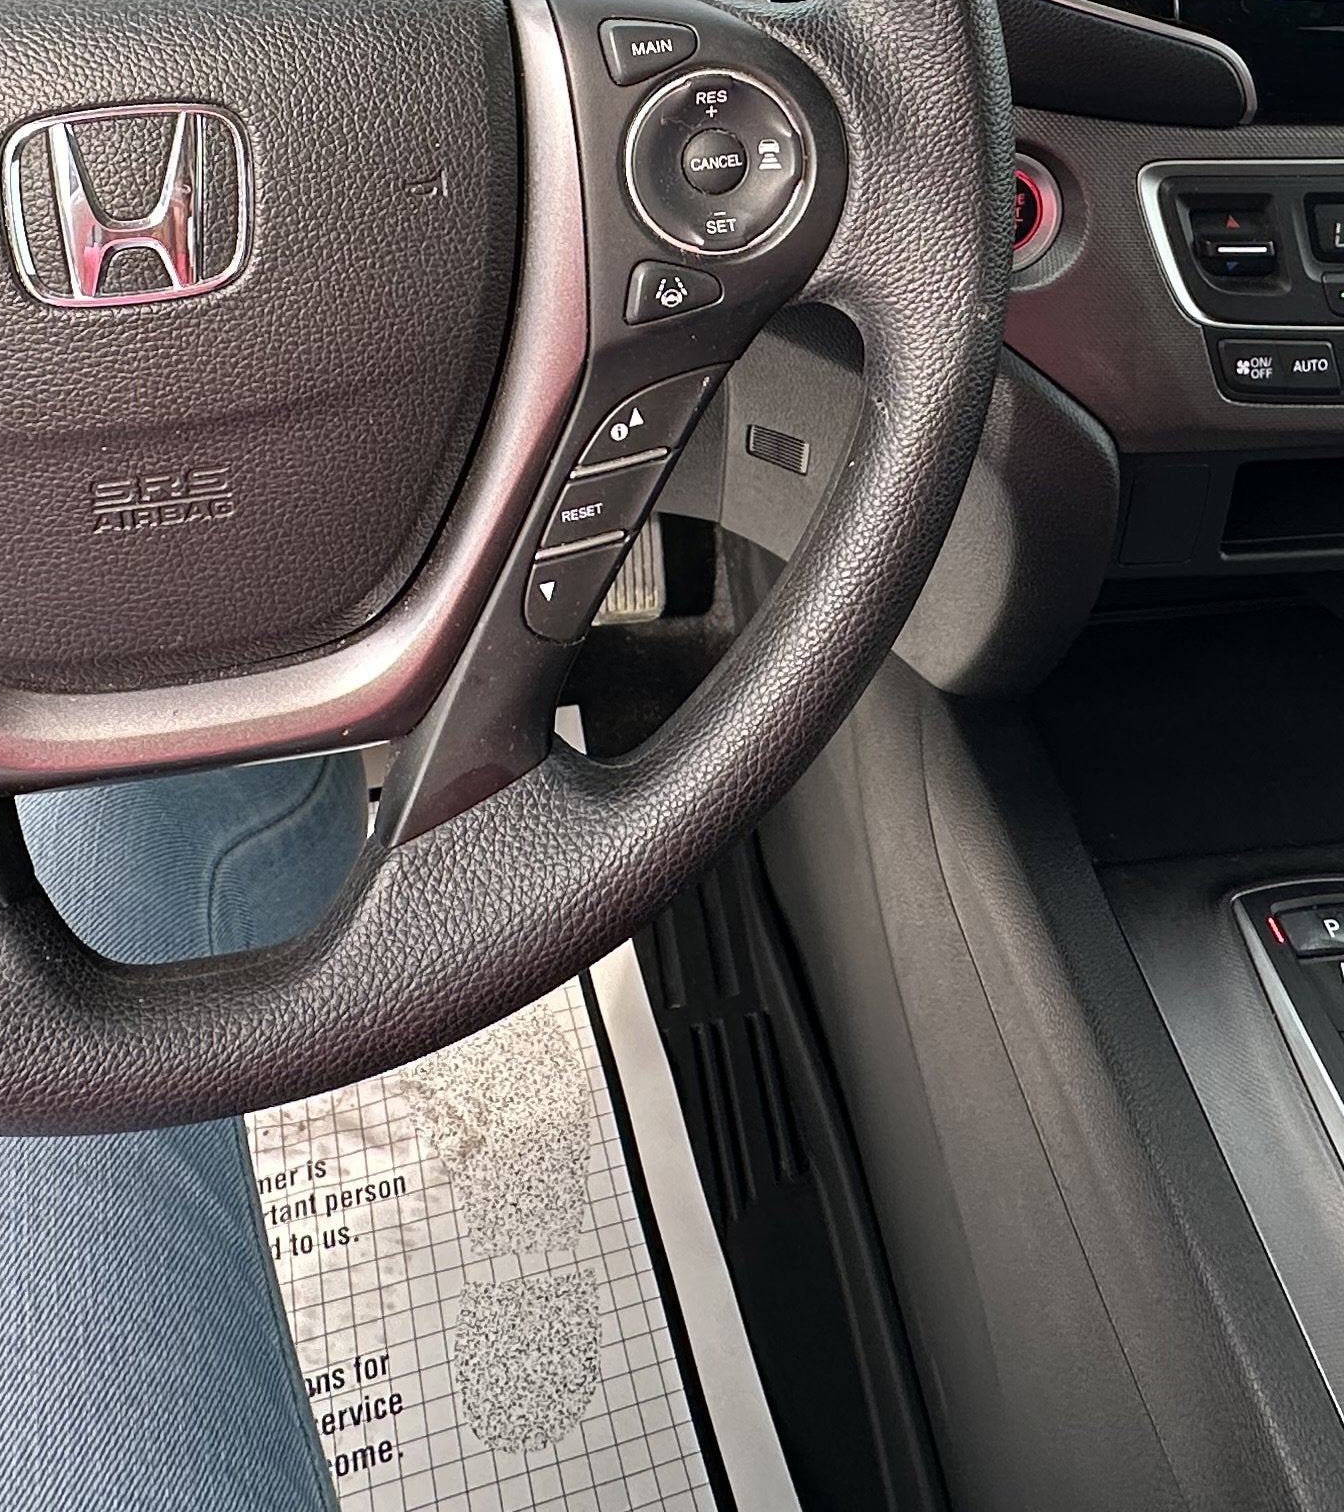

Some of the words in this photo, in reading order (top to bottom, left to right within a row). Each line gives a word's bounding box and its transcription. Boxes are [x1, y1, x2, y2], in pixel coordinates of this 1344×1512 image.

[631, 39, 673, 56] MAIN
[695, 90, 728, 105] RES
[690, 154, 743, 173] CANCEL
[706, 218, 737, 235] SET
[1250, 368, 1273, 380] OFF
[1293, 358, 1329, 373] AUTO
[93, 464, 231, 505] SRS
[93, 494, 235, 534] AIRBAG
[561, 502, 604, 523] RESET
[1323, 918, 1341, 938] P
[306, 1159, 327, 1181] is
[325, 1175, 407, 1217] person
[290, 1234, 313, 1256] to
[323, 1226, 359, 1249] us.
[354, 1353, 390, 1383] for
[316, 1393, 404, 1436] ervice
[327, 1440, 404, 1477] ome.
